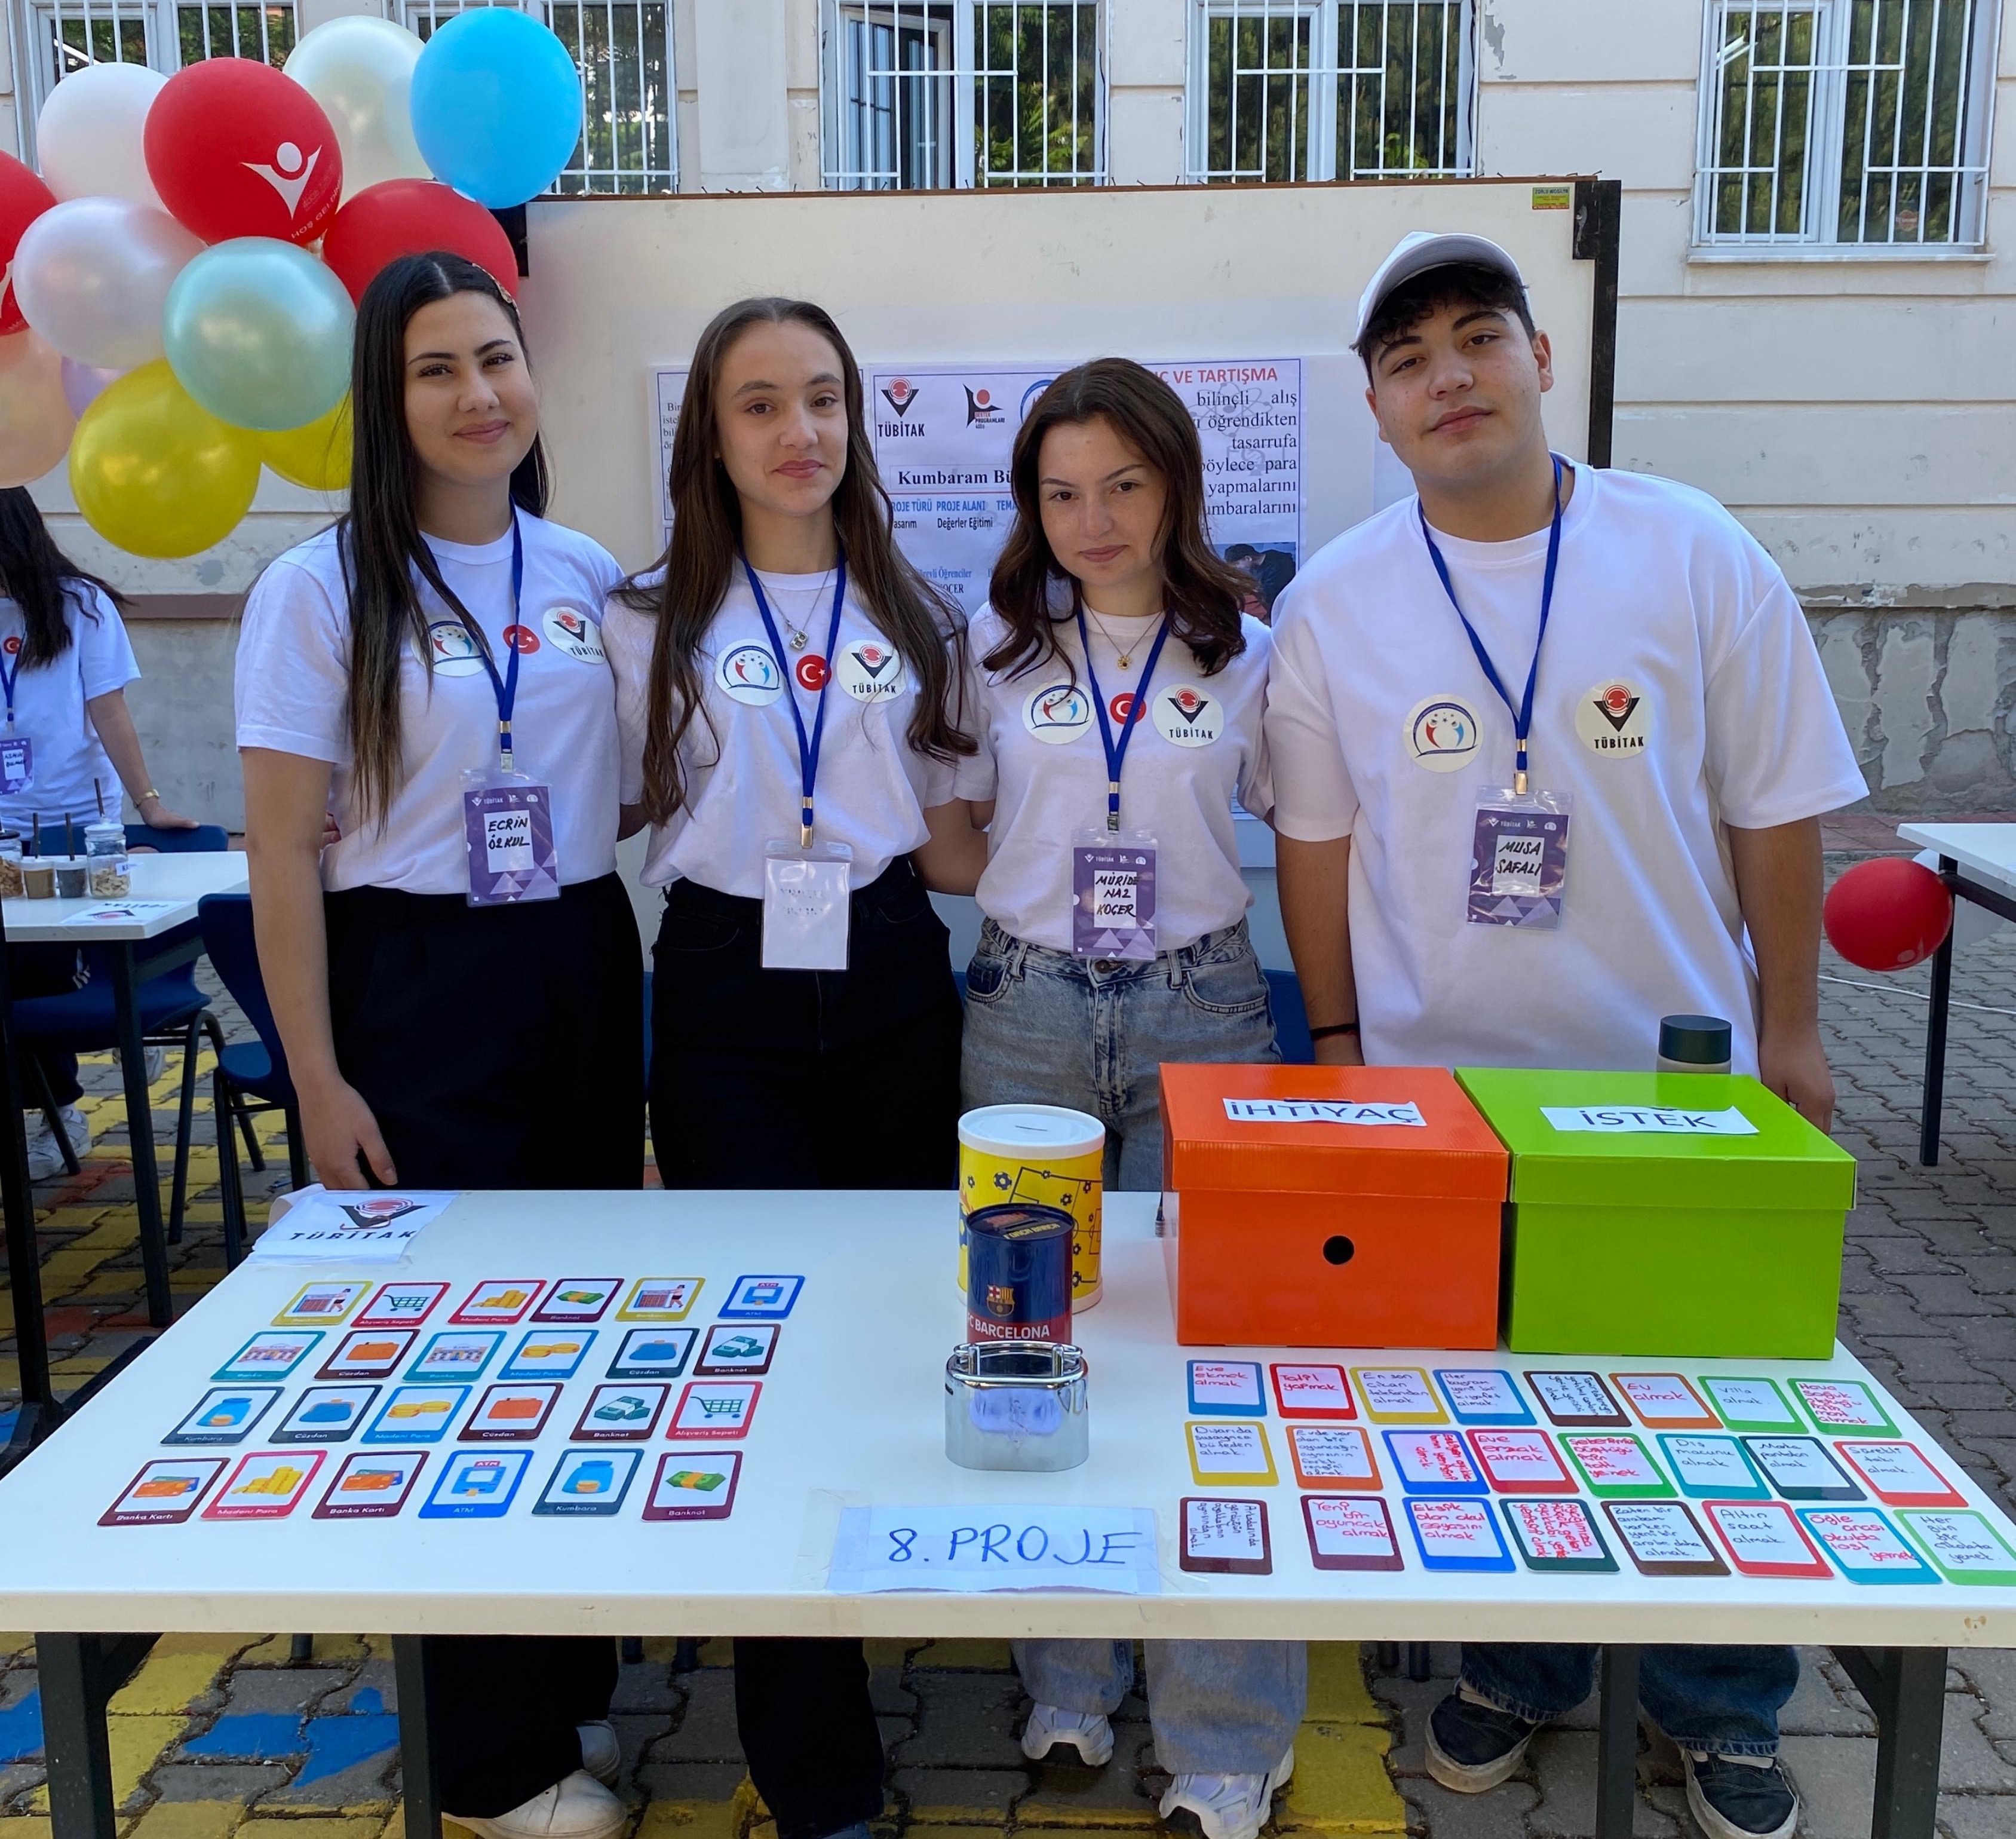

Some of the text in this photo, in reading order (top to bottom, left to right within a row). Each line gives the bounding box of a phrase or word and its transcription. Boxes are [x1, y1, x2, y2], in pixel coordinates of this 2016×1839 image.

[1173, 370, 1192, 384] VE
[1197, 367, 1278, 385] TARTIŞMA
[1196, 389, 1297, 409] bilinçli alış
[1208, 412, 1297, 432] öğrendikten
[877, 421, 925, 437] TÜBİTAK
[1232, 433, 1297, 449] tasarrufa
[1265, 459, 1297, 474] para
[898, 470, 988, 485] Kumbaram
[1208, 478, 1296, 497] yapmalarını
[912, 499, 932, 511] TÜRÜ
[936, 500, 986, 511] PROJE ALANI
[937, 517, 993, 531] Değerler Eğitimi
[938, 566, 972, 579] Öğrenciler
[570, 646, 605, 657] TÜBİTAK
[852, 681, 897, 694] TÜBİTAK
[1169, 727, 1214, 740] TÜBİTAK
[1594, 735, 1644, 750] TÜBİTAK
[487, 816, 528, 832] ECRİN
[1498, 841, 1542, 856] MUSA
[1495, 859, 1542, 876] SAFALI
[1231, 1101, 1418, 1123] İHTİYAÇ
[1579, 1109, 1718, 1129] İSTEK
[289, 1230, 418, 1240] TÜBİTAK
[975, 1318, 1050, 1340] BARCELONA
[1195, 1379, 1242, 1388] almak
[1799, 1383, 1837, 1391] Hava
[1633, 1391, 1687, 1401] almak
[1486, 1454, 1549, 1462] almak
[1675, 1448, 1735, 1457] macunu
[1681, 1457, 1730, 1467] almak
[1312, 1501, 1350, 1512] Yeni
[1720, 1509, 1768, 1519] Altın
[1809, 1513, 1854, 1525] Öğle
[1920, 1516, 1951, 1524] Her
[1315, 1519, 1387, 1529] oyuncak
[1727, 1522, 1773, 1530] saat
[1842, 1524, 1885, 1532] arası
[1342, 1529, 1390, 1539] almak
[1424, 1531, 1476, 1541] almak
[888, 1524, 1143, 1565] 8. PROJE
[1830, 1542, 1870, 1551] tost
